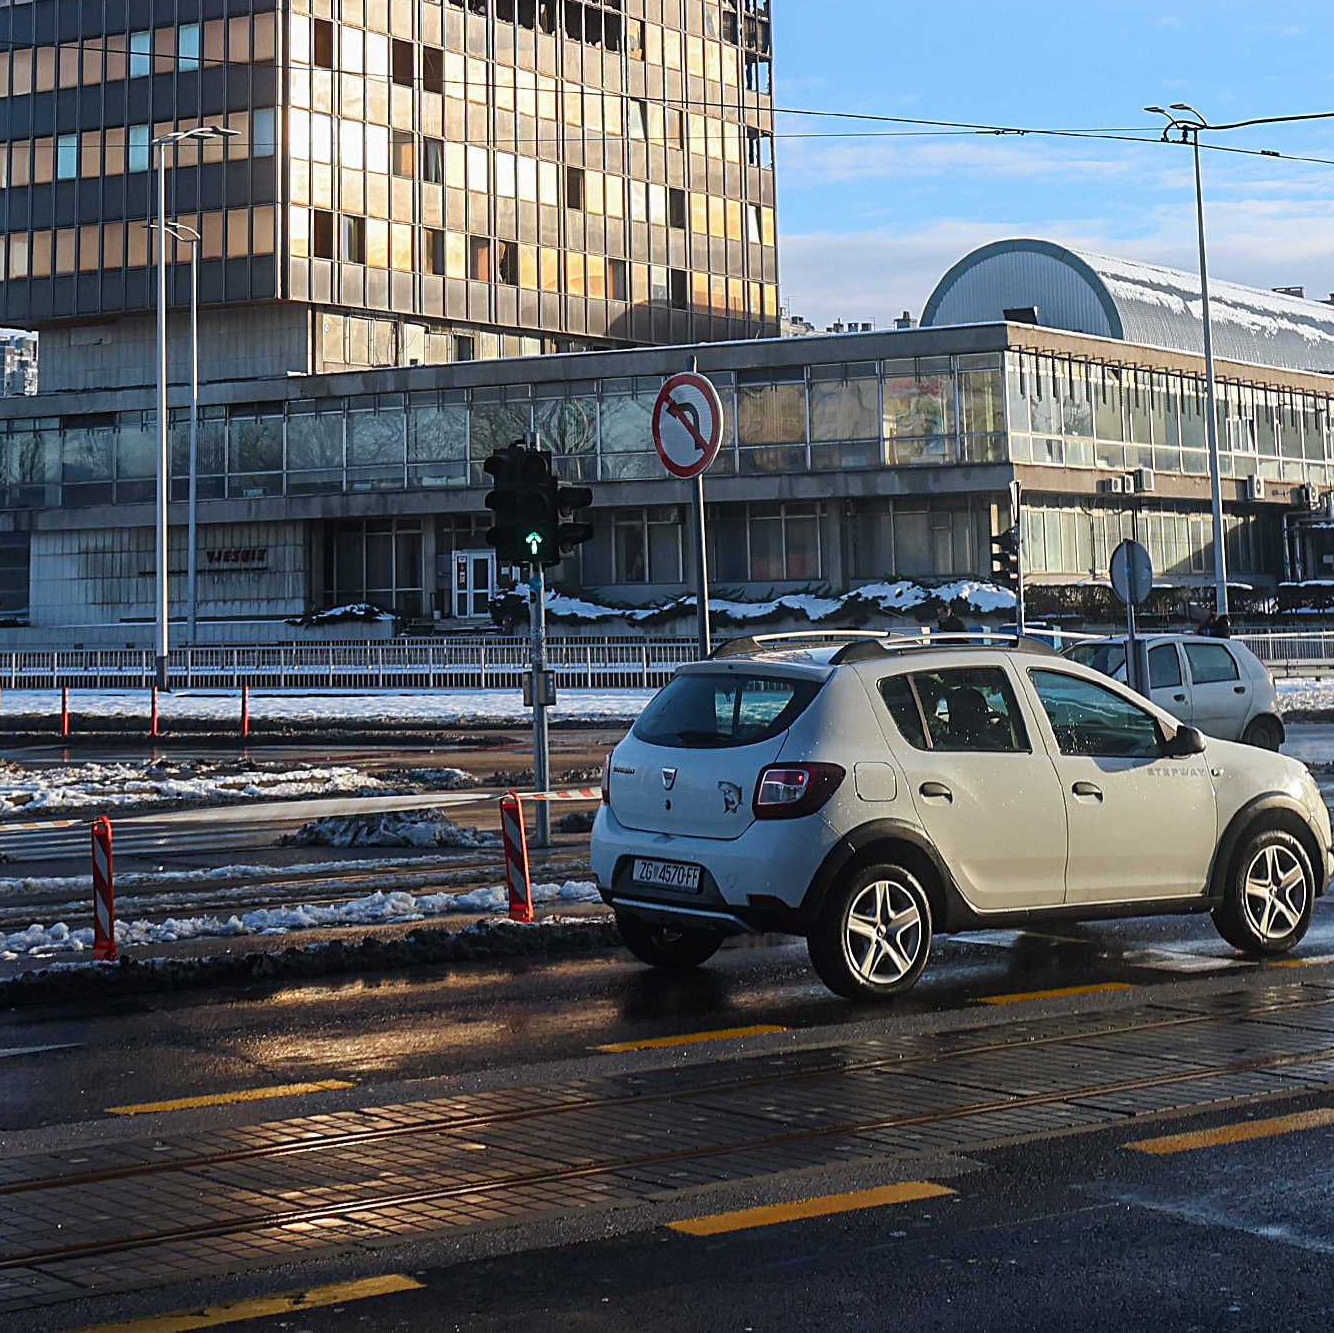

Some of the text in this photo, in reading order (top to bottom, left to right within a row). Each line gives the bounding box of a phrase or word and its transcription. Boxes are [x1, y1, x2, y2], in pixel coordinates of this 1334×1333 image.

[206, 548, 267, 563] VJESNIK
[1147, 767, 1205, 777] STEPWAY
[639, 861, 654, 881] ZG
